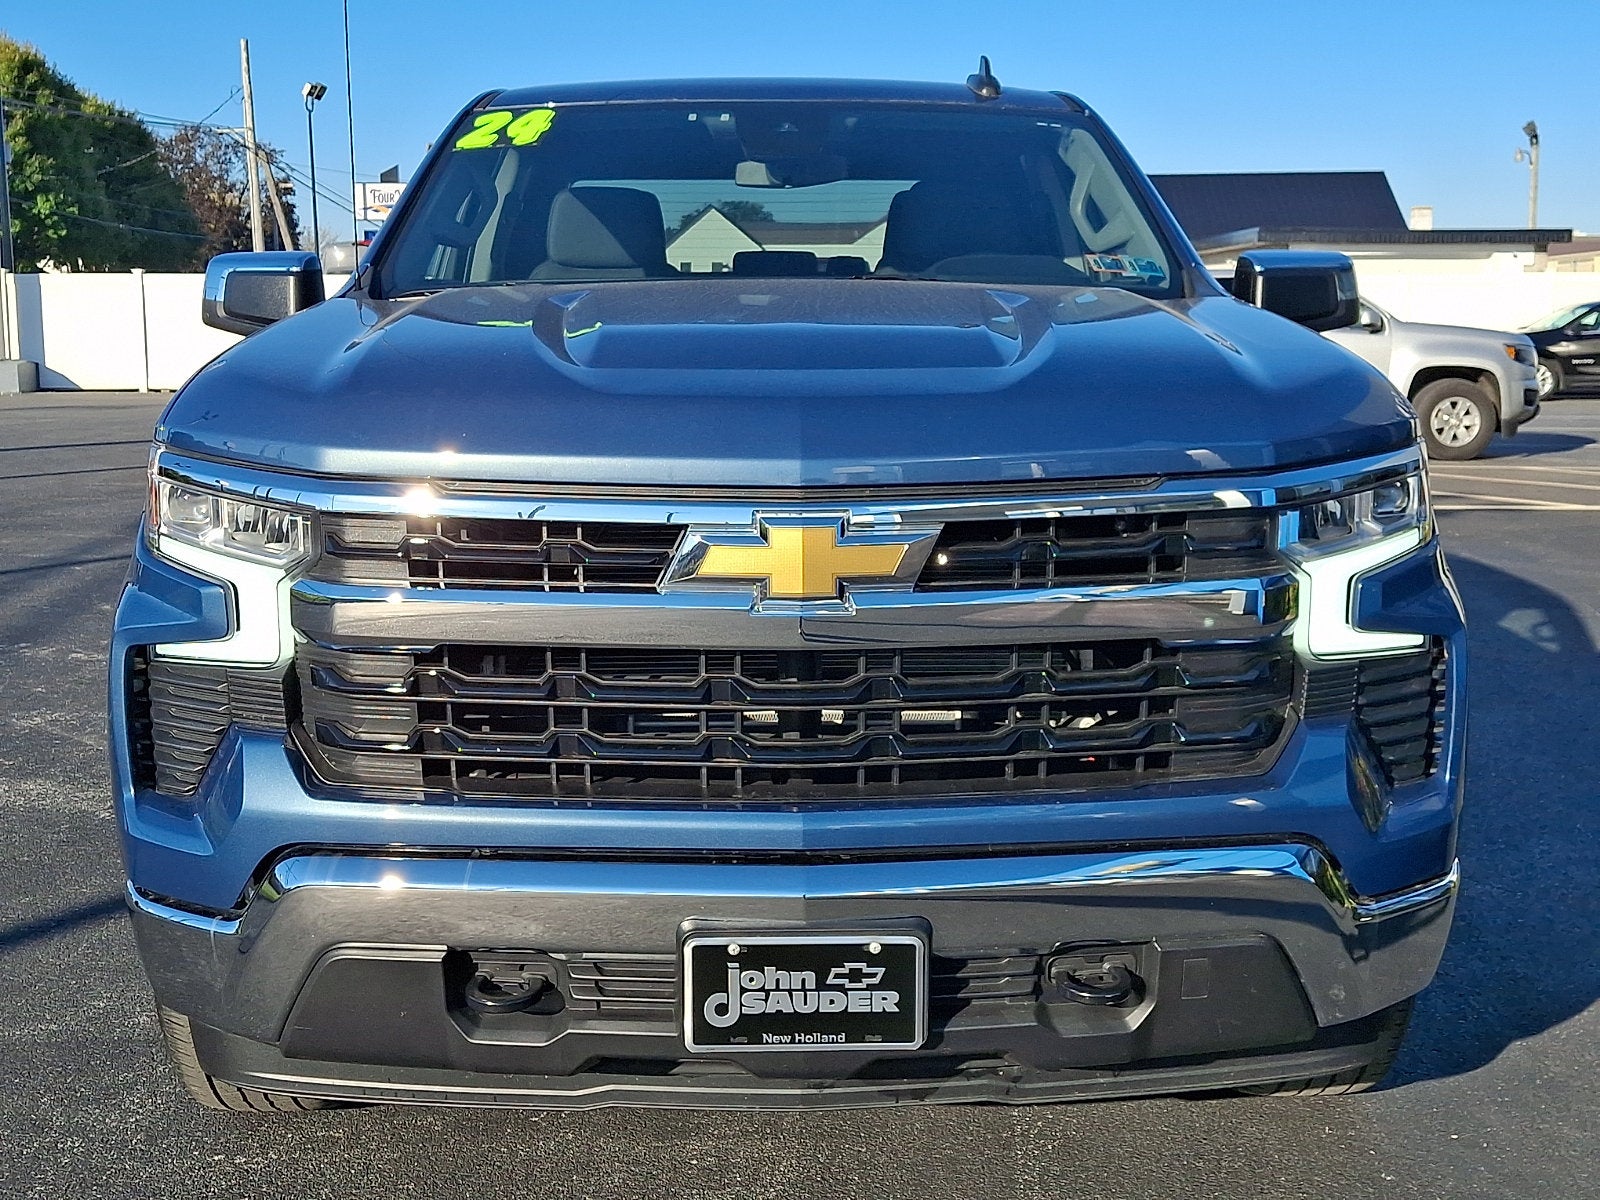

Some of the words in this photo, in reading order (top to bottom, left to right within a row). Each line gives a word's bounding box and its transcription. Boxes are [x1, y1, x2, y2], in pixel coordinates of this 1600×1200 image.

[455, 109, 556, 149] 24
[741, 990, 900, 1015] SAUDER
[762, 1033, 793, 1044] New
[795, 1032, 846, 1043] Holland
